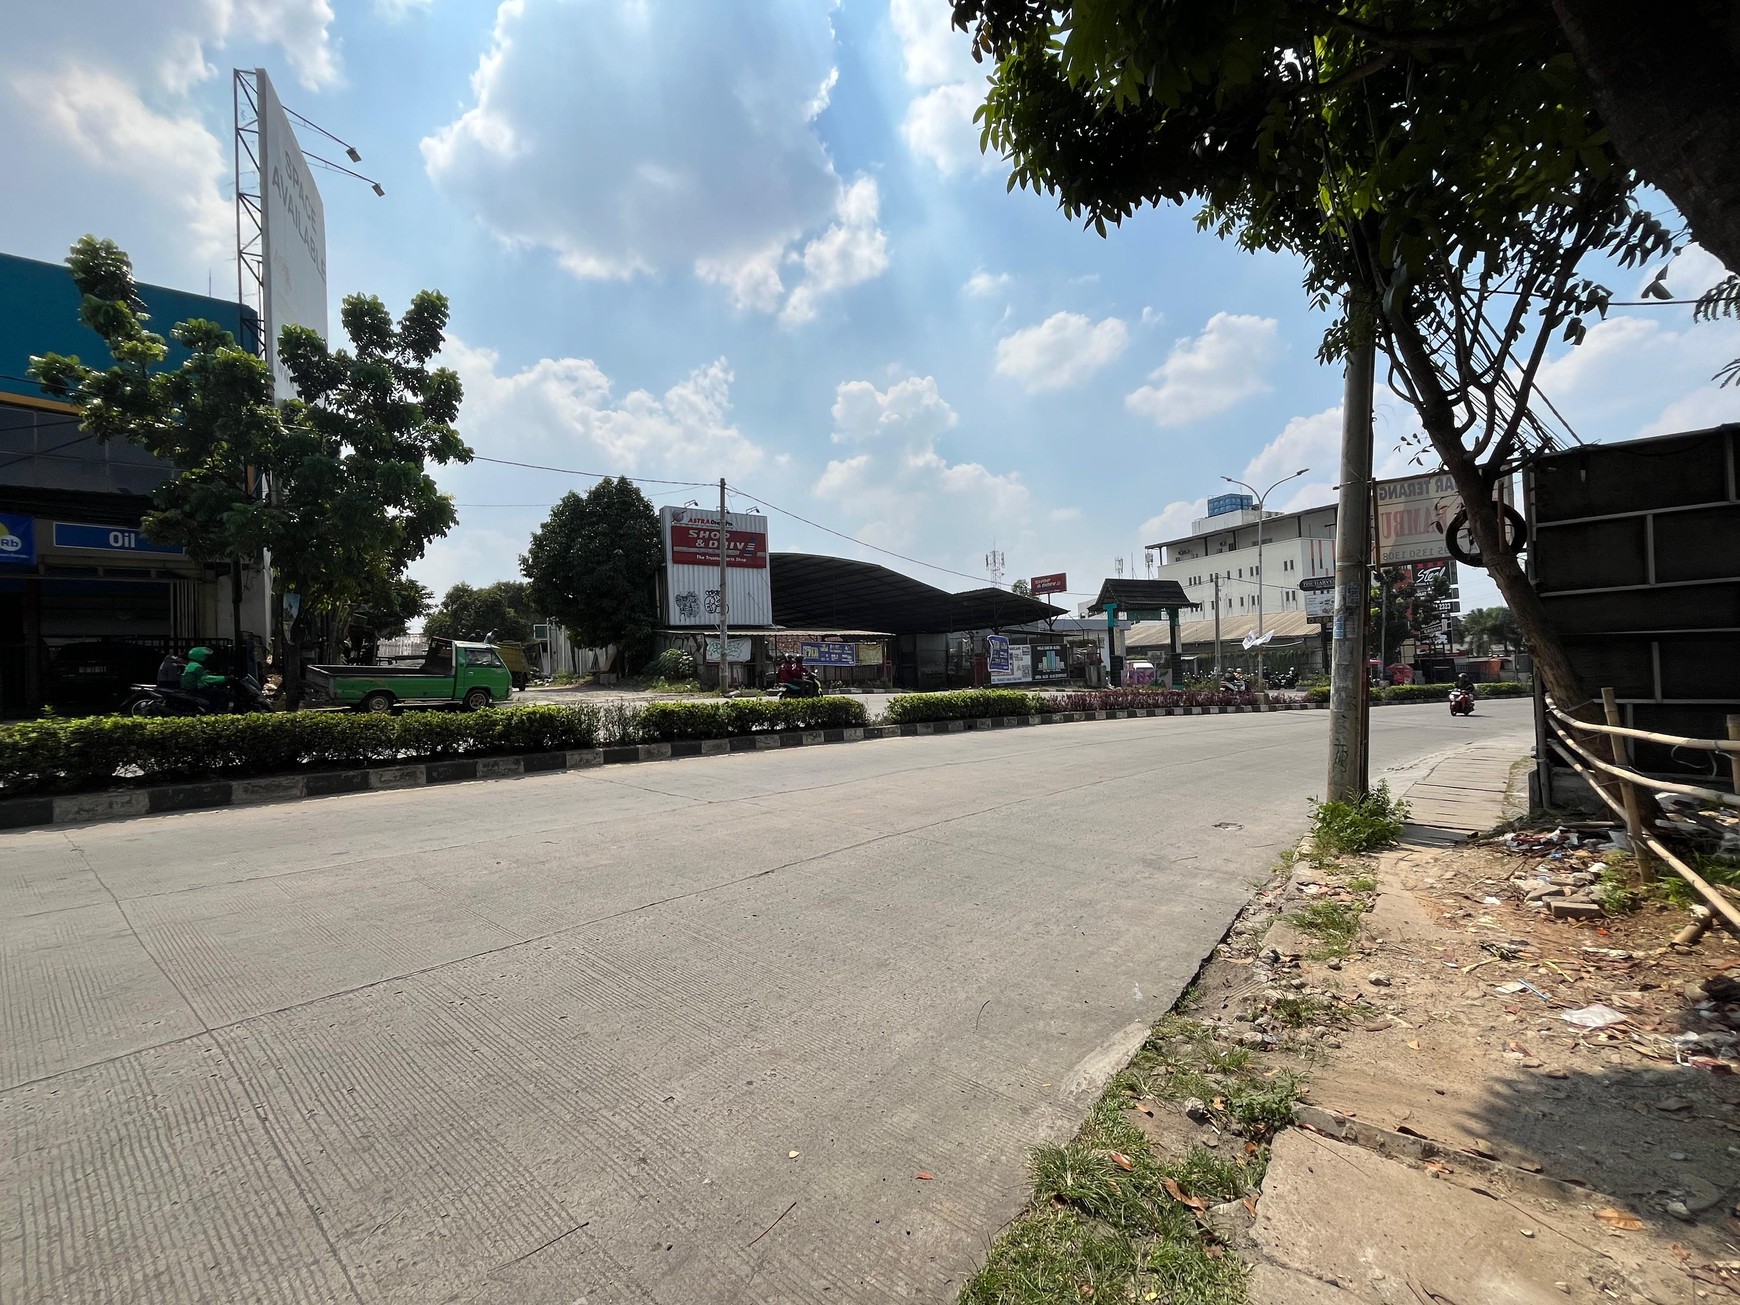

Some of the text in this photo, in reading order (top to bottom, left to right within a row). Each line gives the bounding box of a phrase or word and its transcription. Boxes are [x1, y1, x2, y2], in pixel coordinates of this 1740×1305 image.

[285, 150, 317, 234] SPACE
[272, 165, 326, 284] AVAILABLE
[109, 531, 135, 548] Oil
[695, 539, 756, 552] & DIVE
